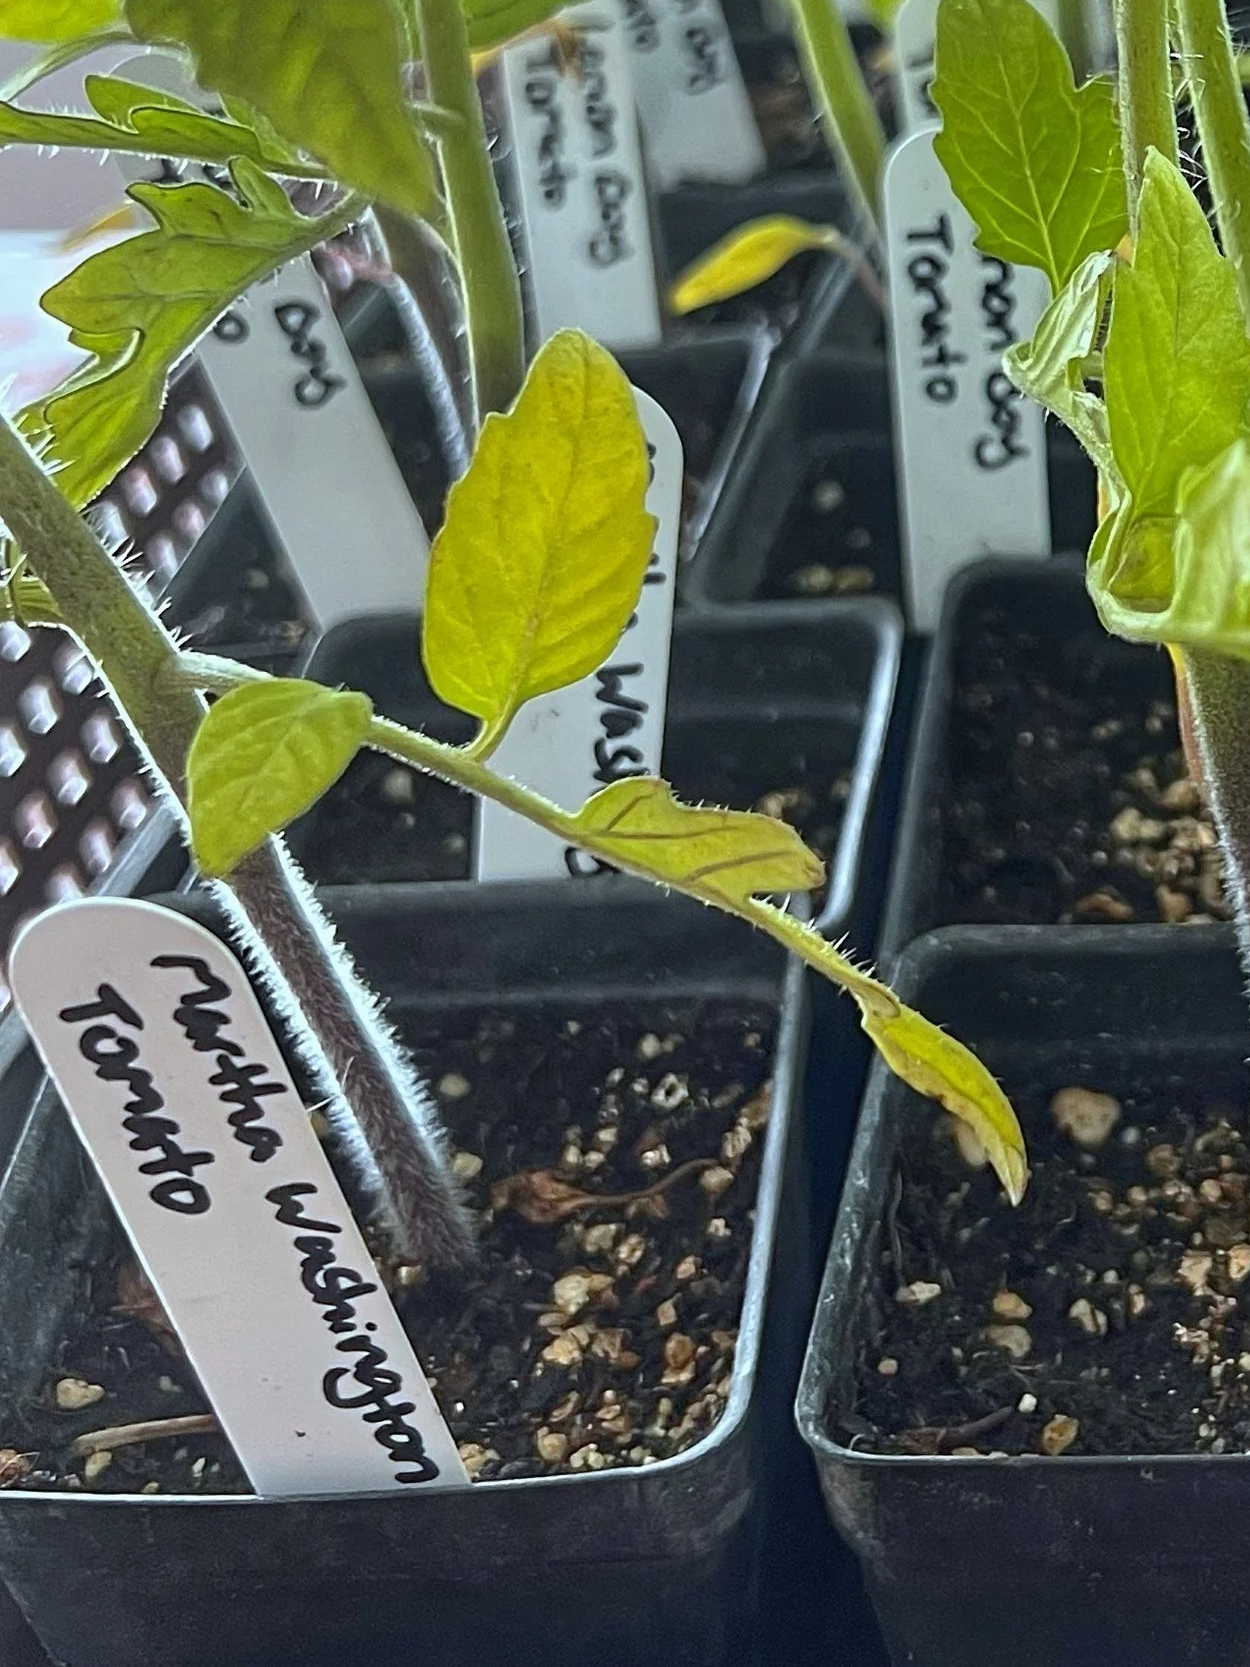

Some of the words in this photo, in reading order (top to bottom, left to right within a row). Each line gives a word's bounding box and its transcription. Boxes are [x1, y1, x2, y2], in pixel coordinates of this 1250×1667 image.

[58, 983, 213, 1215] Tomato
[150, 955, 287, 1163] Martha
[265, 1183, 440, 1484] Washington
